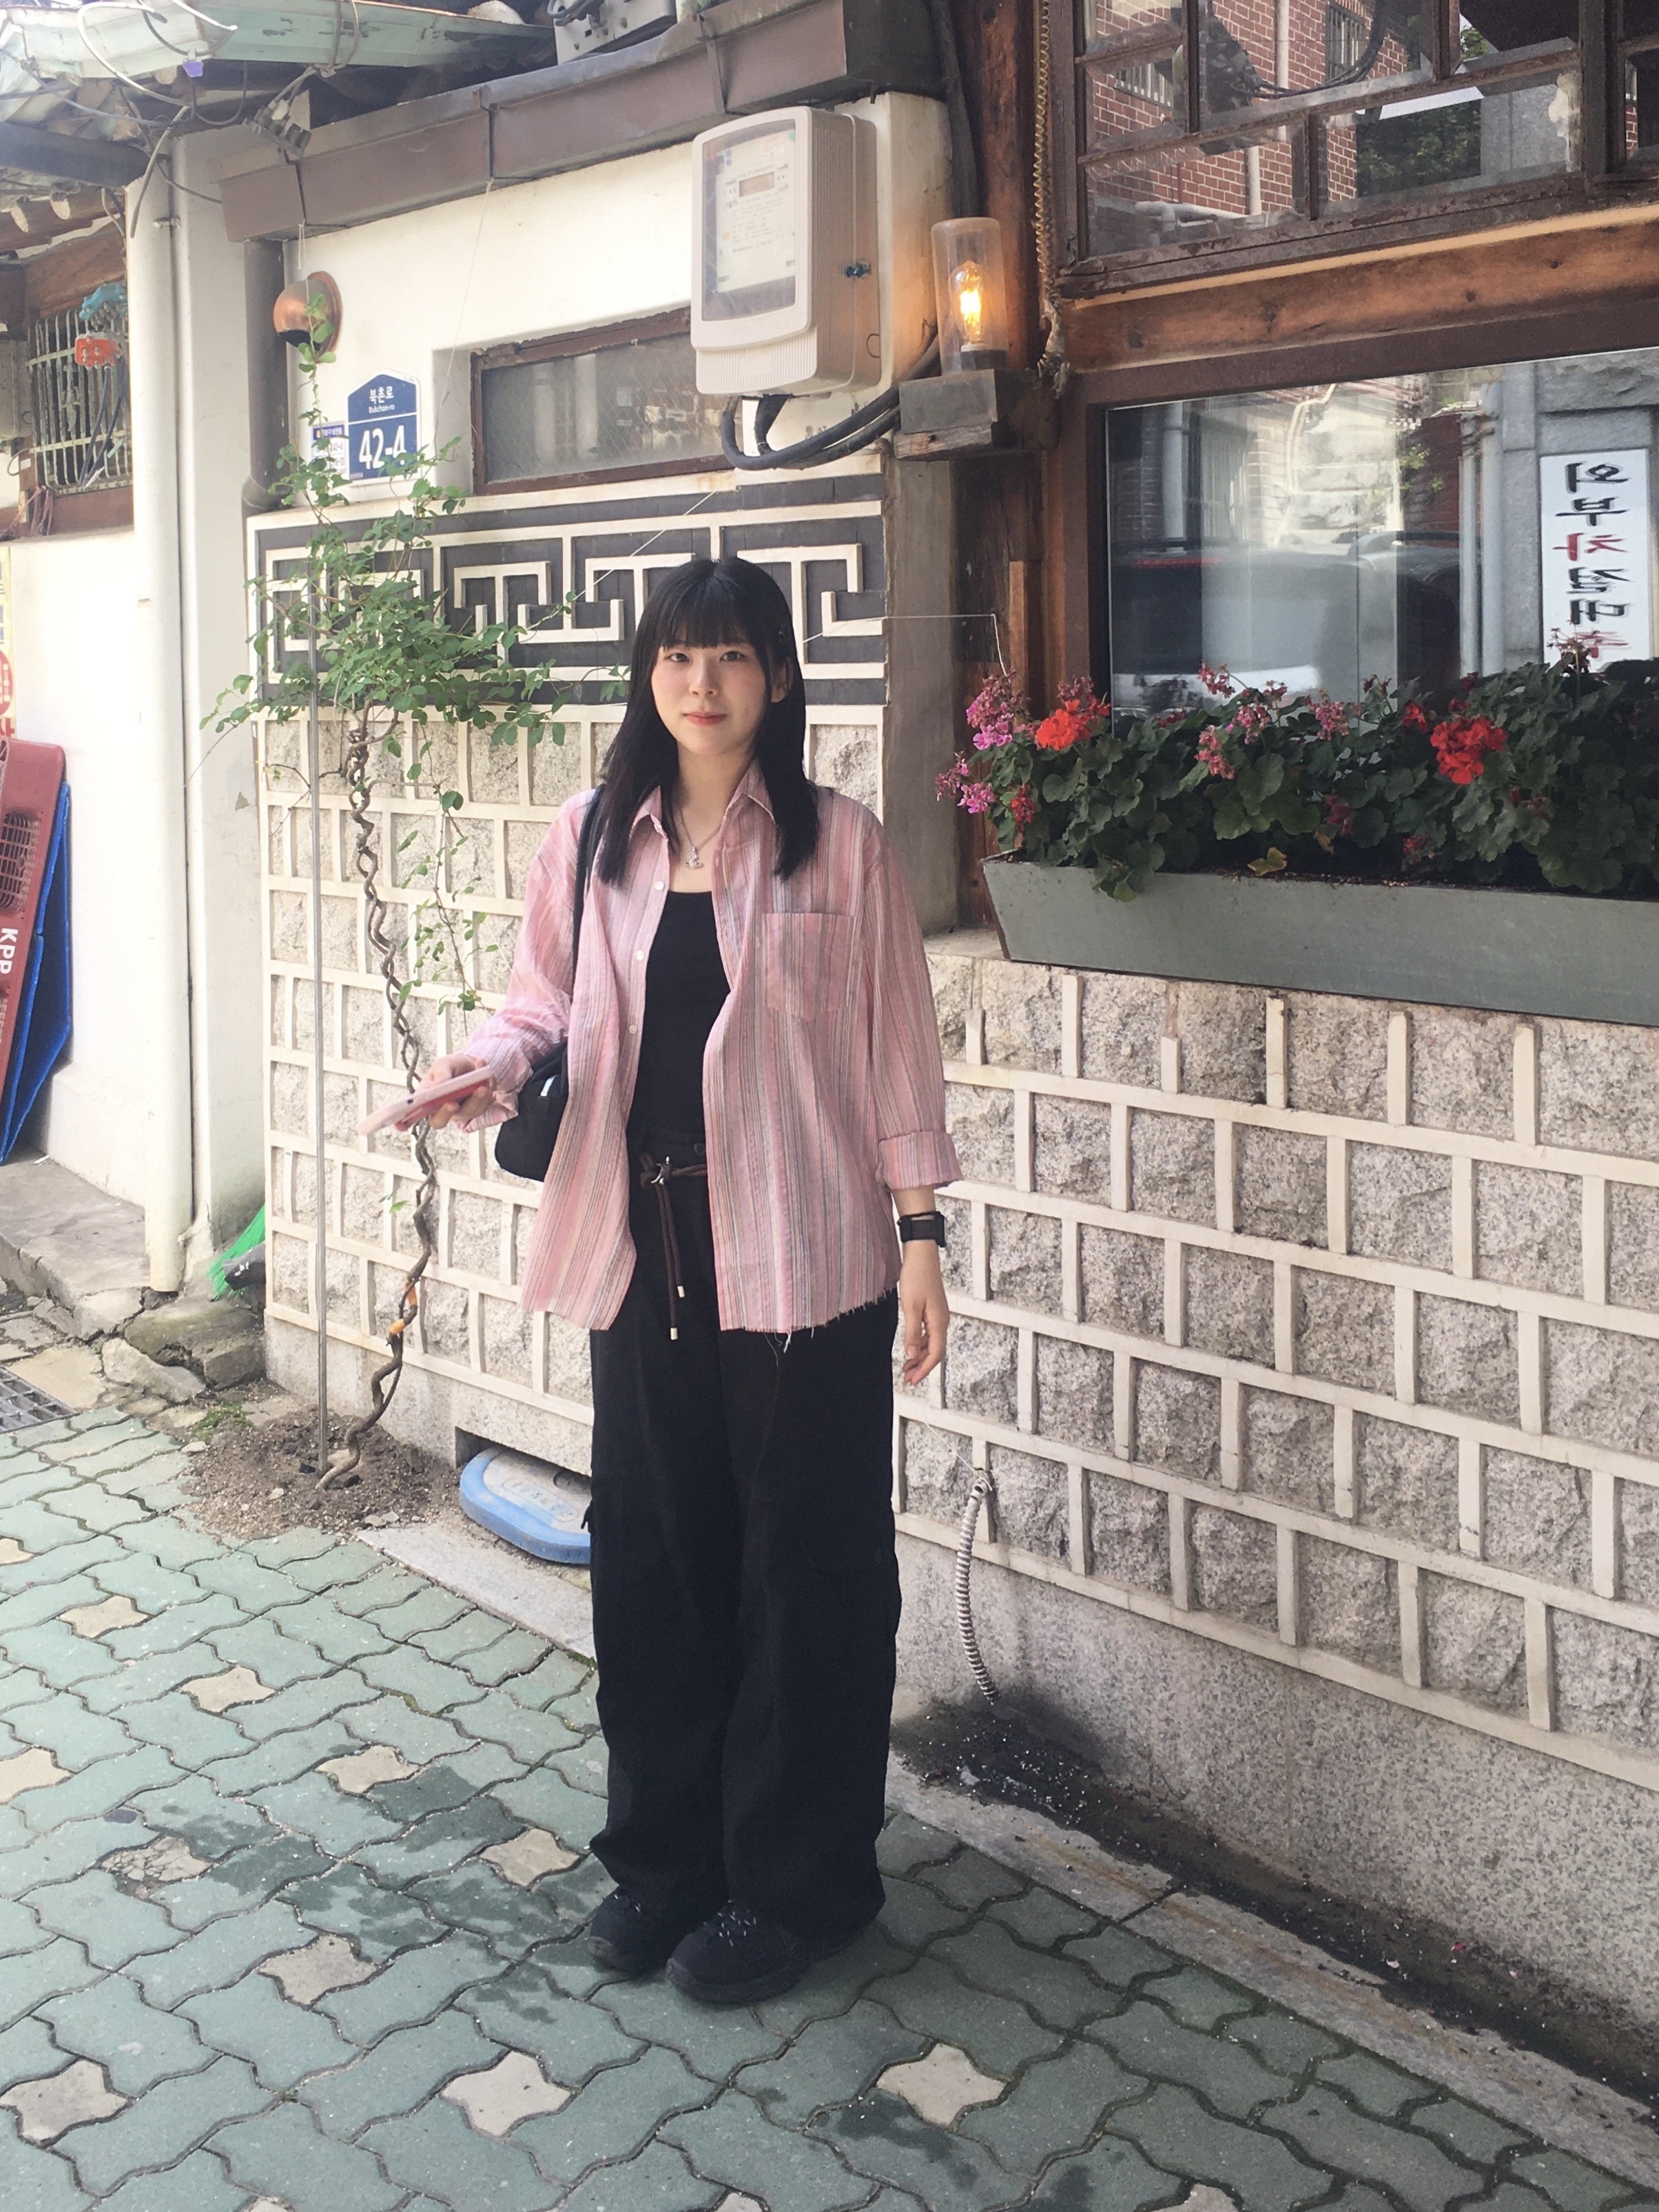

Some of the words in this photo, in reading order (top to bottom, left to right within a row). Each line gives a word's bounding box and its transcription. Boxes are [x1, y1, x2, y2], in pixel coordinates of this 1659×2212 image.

[369, 386, 394, 404] 북촌로
[359, 425, 406, 470] 42-4
[0, 928, 19, 975] KPP
